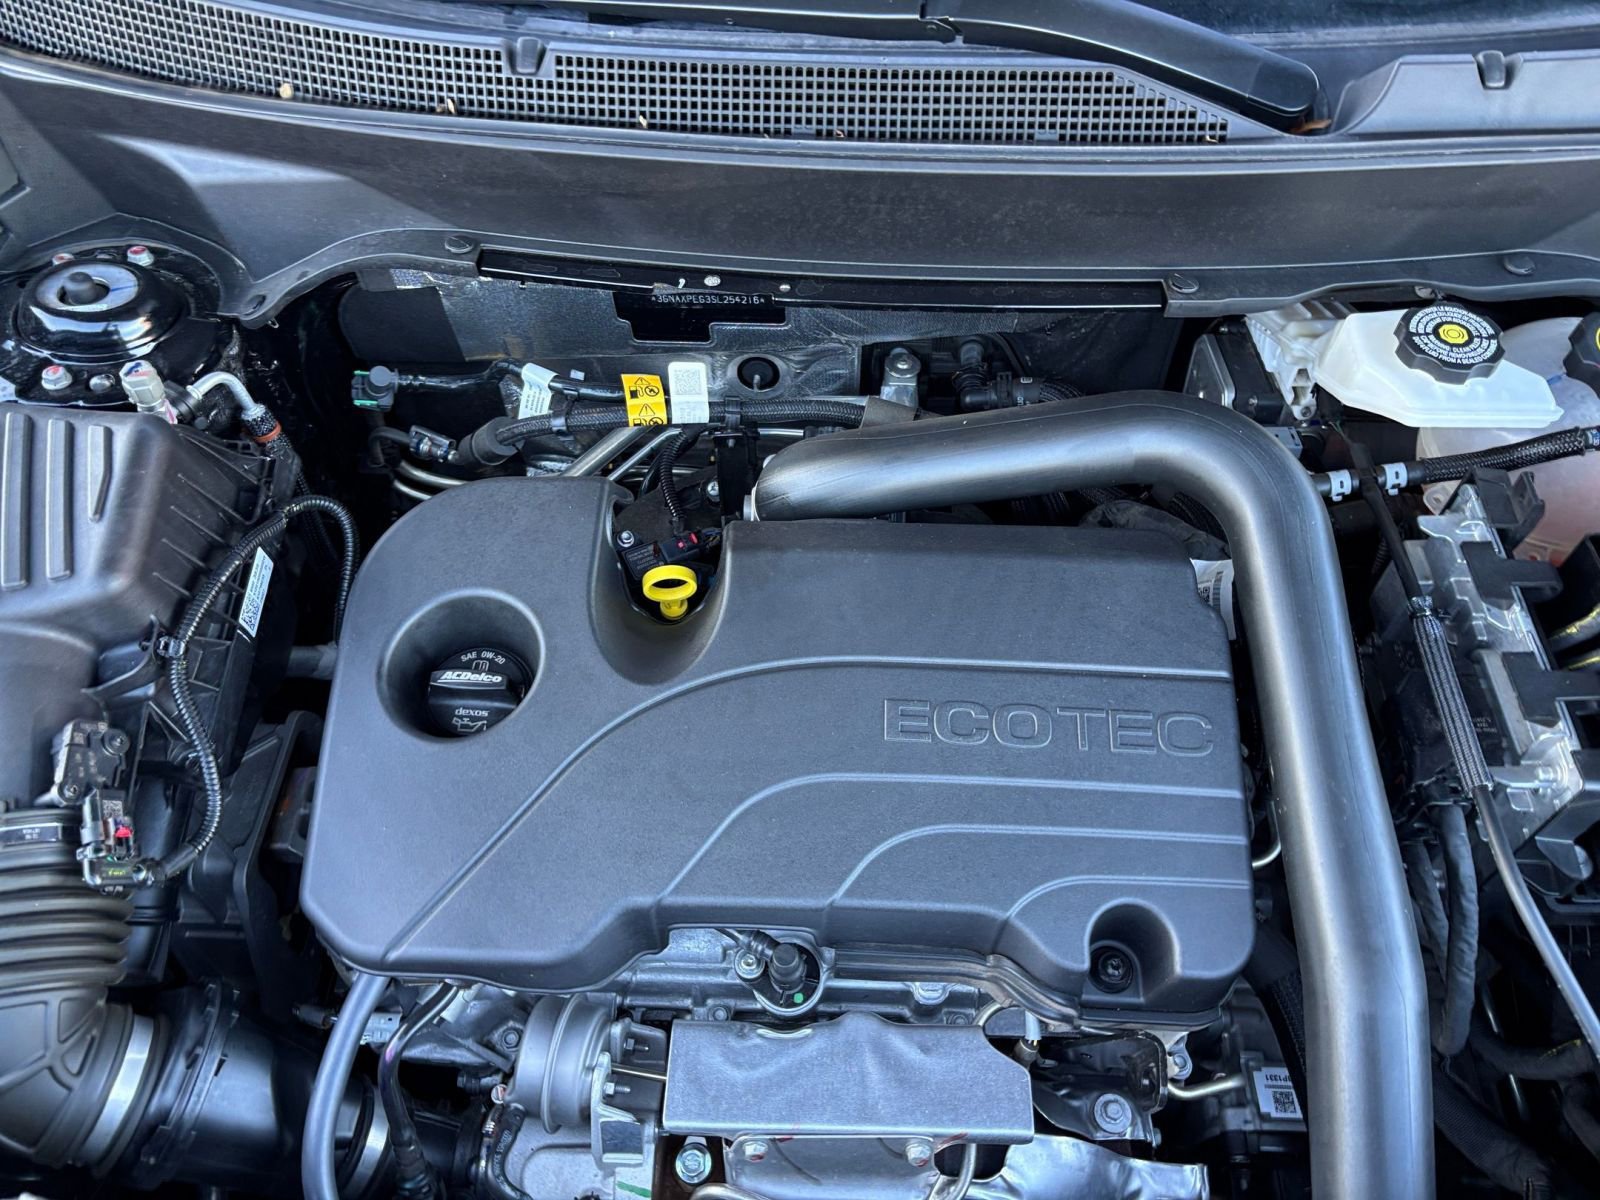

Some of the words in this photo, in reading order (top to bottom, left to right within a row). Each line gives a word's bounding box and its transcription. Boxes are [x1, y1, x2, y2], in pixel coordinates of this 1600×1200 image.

[1438, 354, 1456, 363] FROM
[461, 651, 477, 662] SAE
[481, 650, 506, 665] 0W-20
[440, 671, 502, 683] ACDelco
[455, 707, 490, 717] dexos
[884, 699, 1214, 758] ECOTEC
